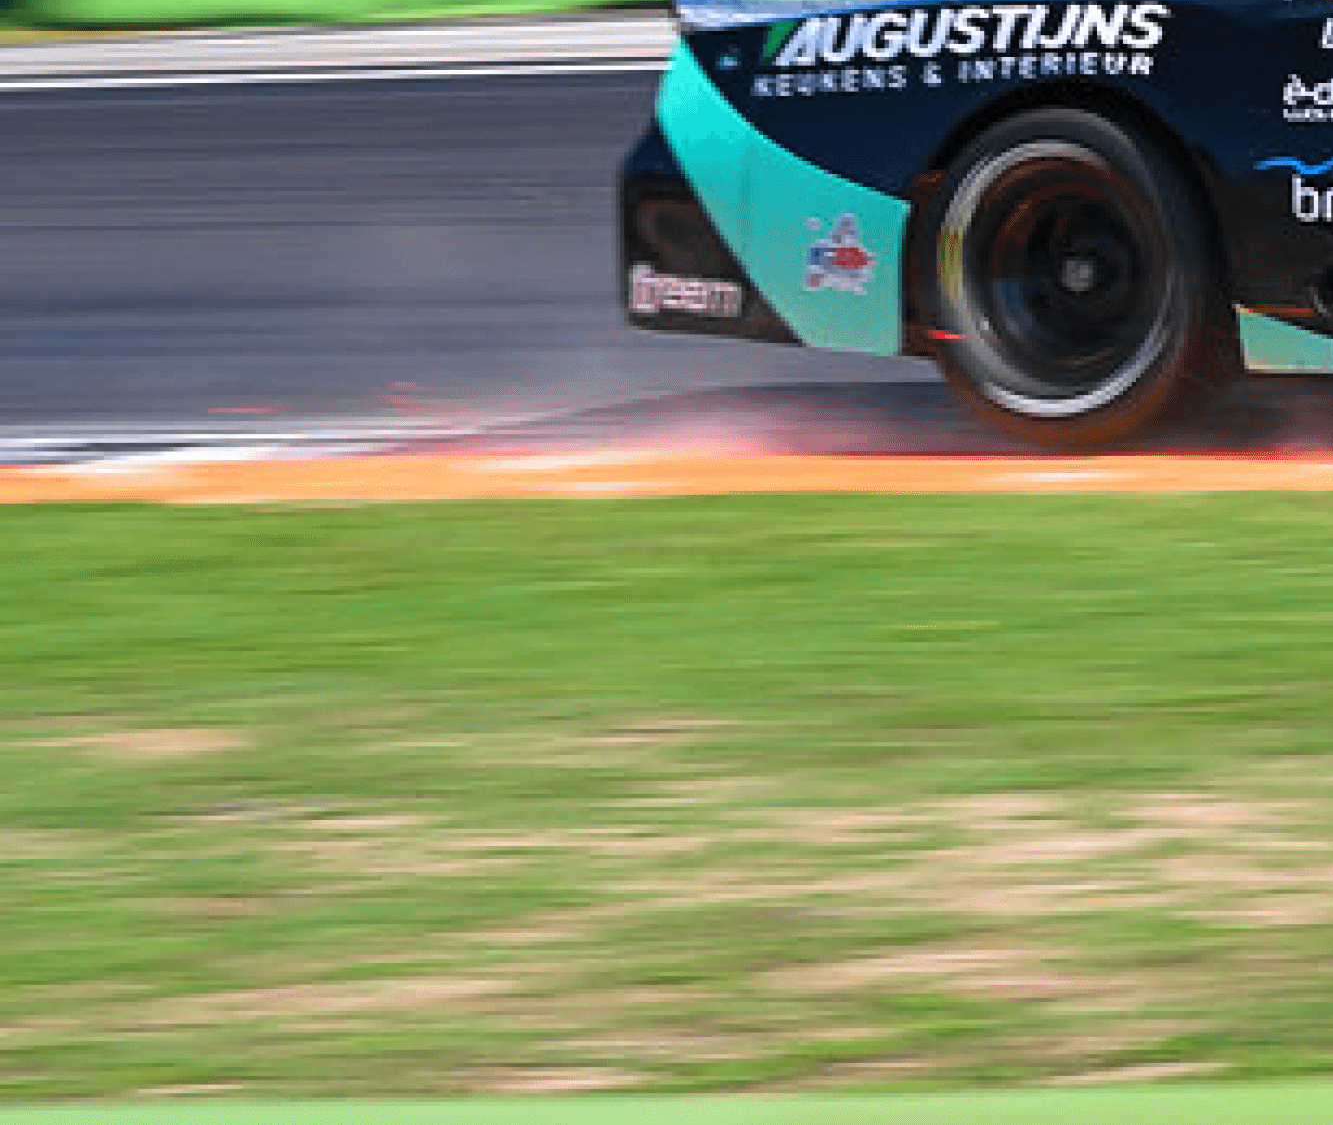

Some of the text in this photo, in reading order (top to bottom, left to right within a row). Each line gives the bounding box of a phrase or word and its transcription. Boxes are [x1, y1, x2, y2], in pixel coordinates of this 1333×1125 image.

[773, 3, 1171, 66] AUGUSTIJNS
[752, 51, 1155, 97] KEUKENS & INTERIEUR
